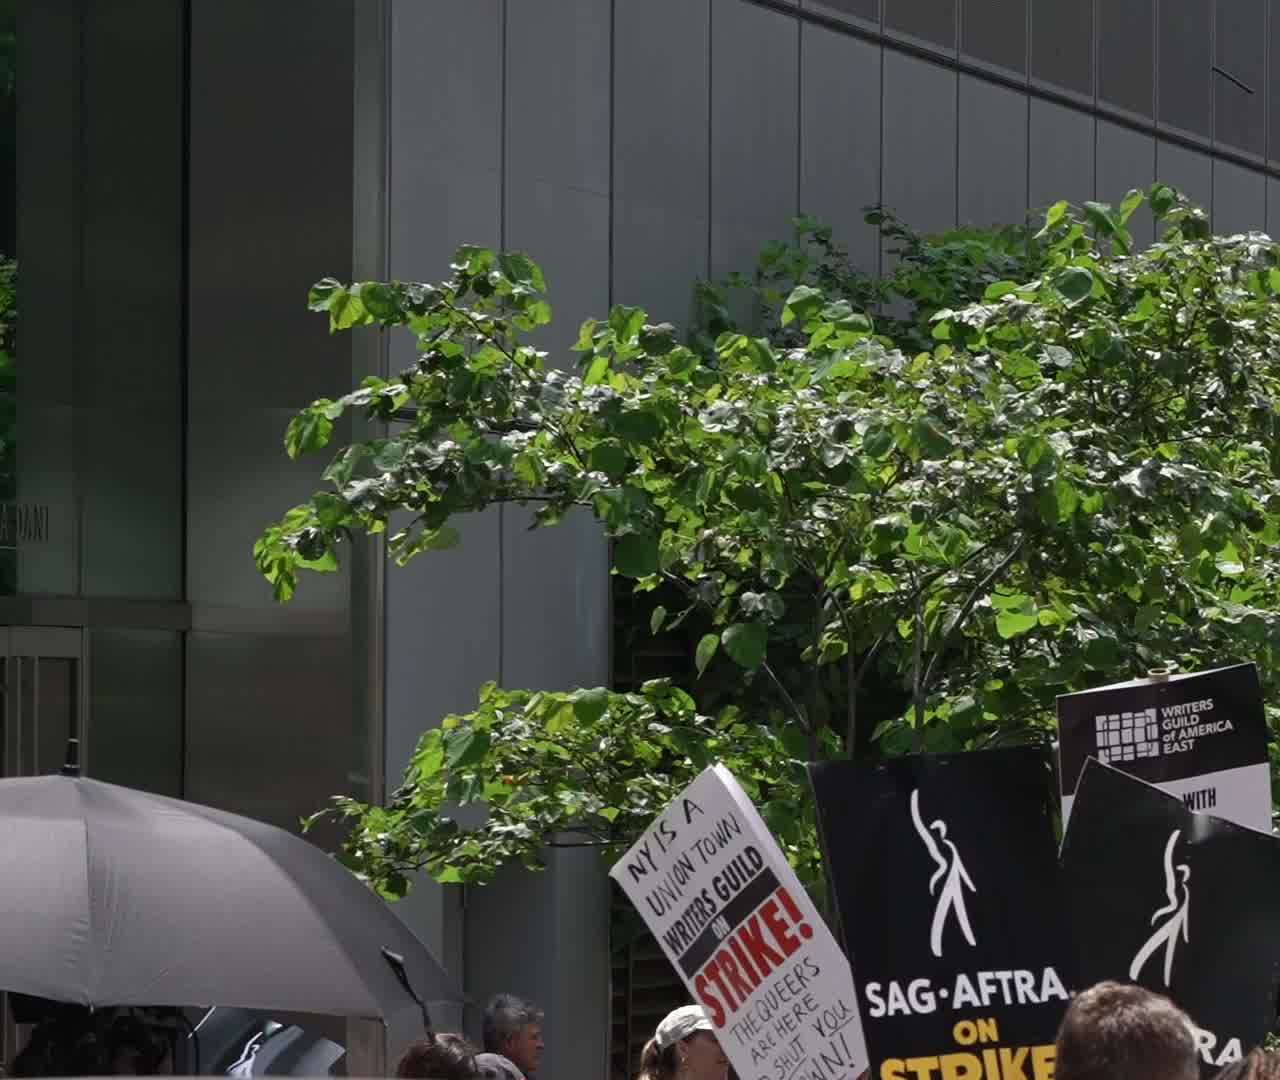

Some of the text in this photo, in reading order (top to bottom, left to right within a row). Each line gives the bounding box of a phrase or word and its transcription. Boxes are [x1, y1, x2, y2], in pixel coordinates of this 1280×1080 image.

[1161, 698, 1214, 718] WRITERS
[1162, 714, 1200, 731] GUILD
[1162, 719, 1233, 742] of AMERICA
[1163, 740, 1195, 754] EAST
[1183, 787, 1216, 810] WITH
[627, 799, 704, 884] NY IS A
[646, 812, 742, 917] UNION TOWN
[662, 845, 764, 956] WRITERS GUILD
[712, 916, 731, 941] ON
[695, 885, 814, 1029] STRIKE!
[760, 957, 820, 1020] QUEERS
[750, 993, 819, 1065] ARE HERE
[775, 1038, 808, 1080] SHUT
[812, 999, 853, 1036] YOU
[953, 1018, 998, 1045] ON
